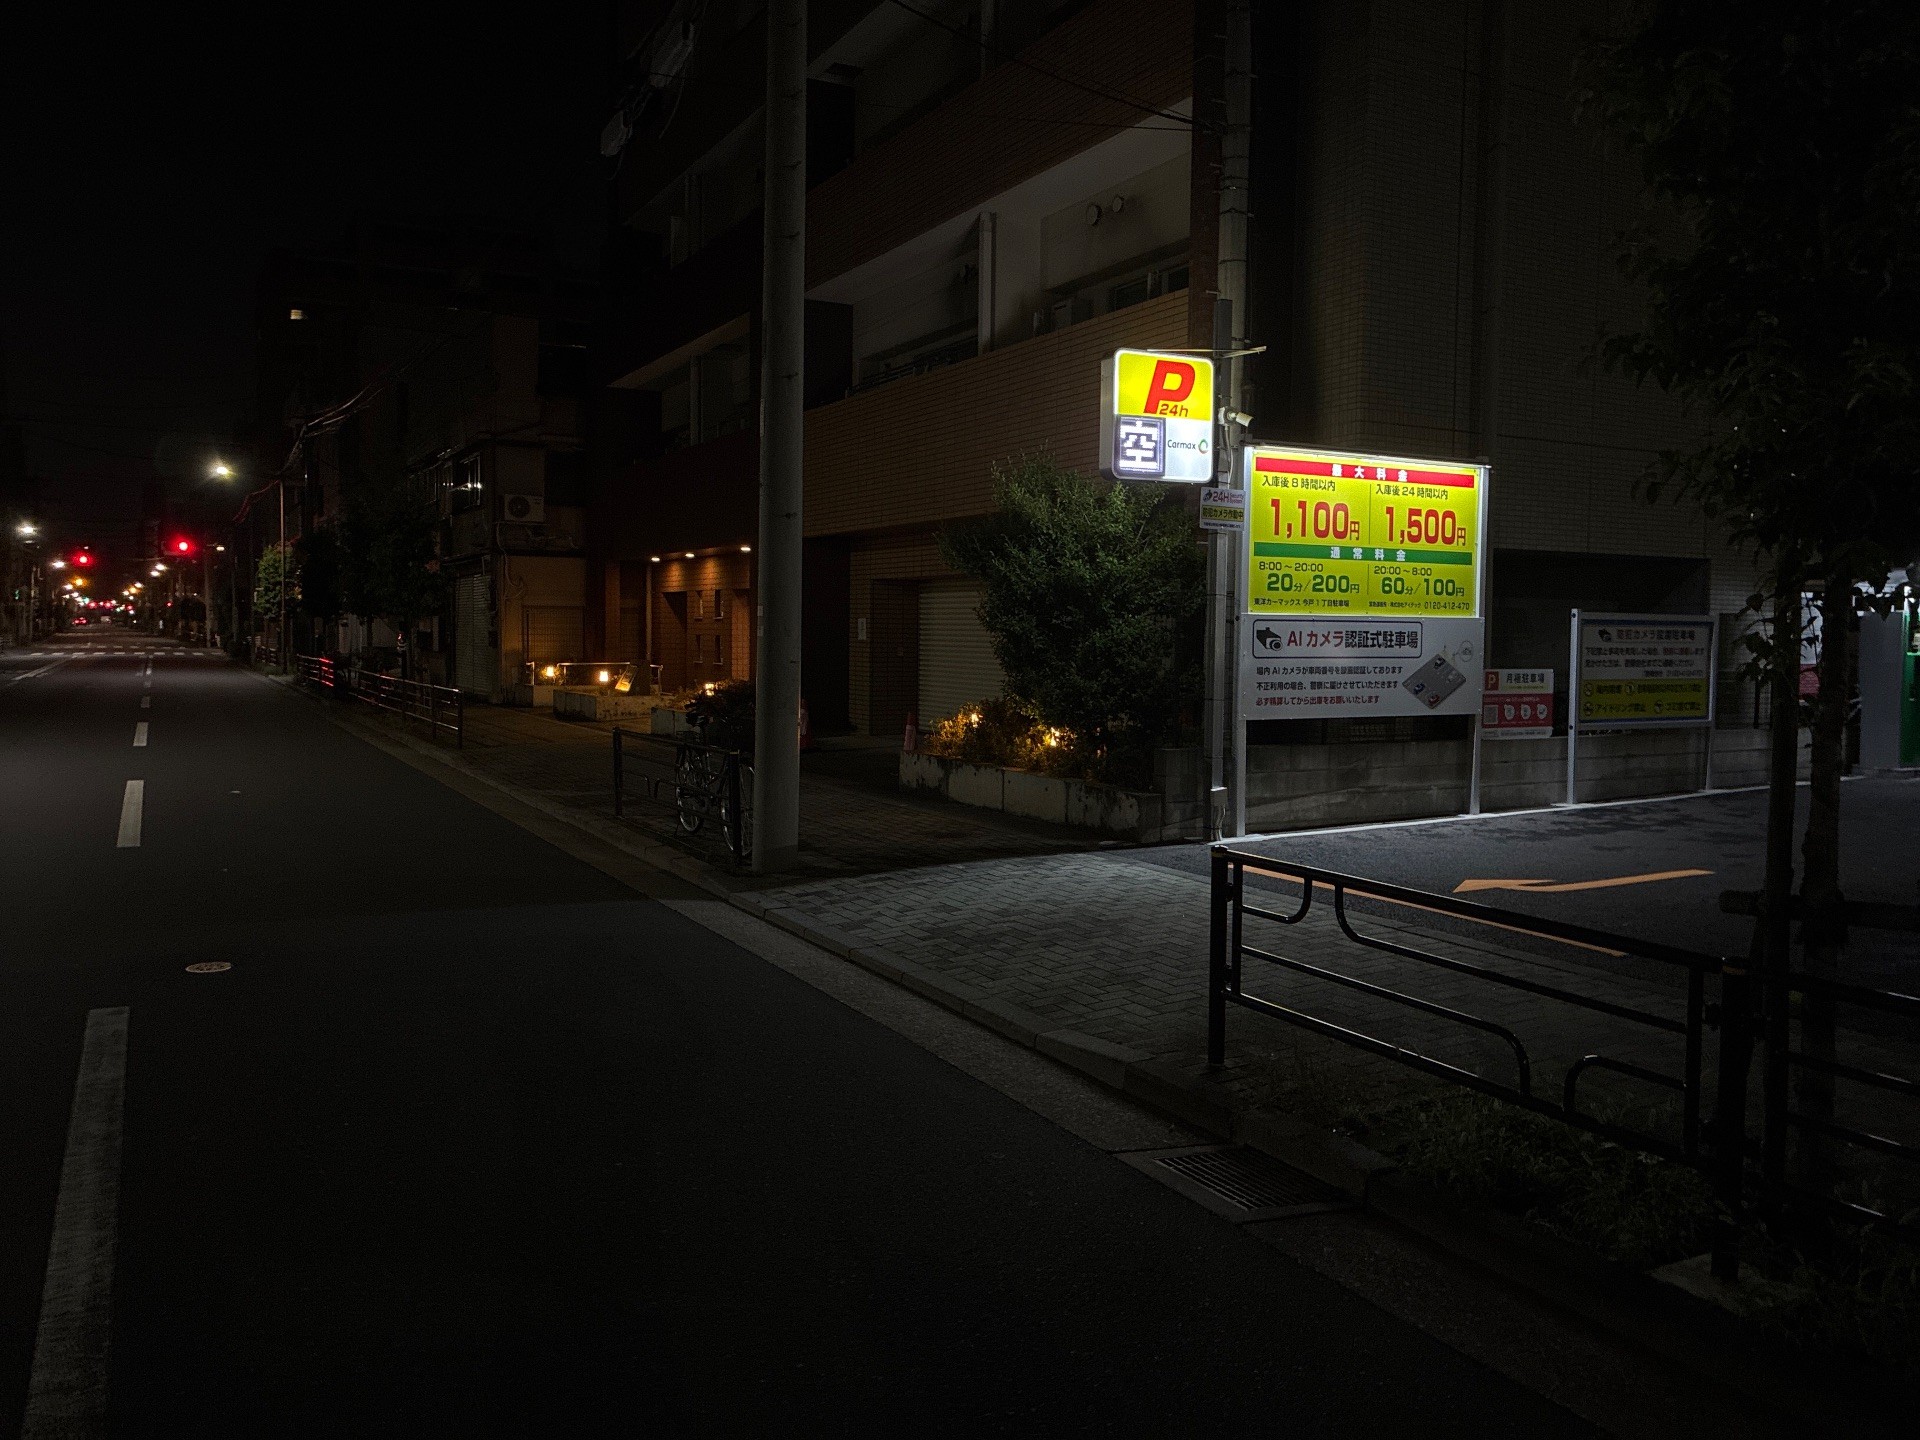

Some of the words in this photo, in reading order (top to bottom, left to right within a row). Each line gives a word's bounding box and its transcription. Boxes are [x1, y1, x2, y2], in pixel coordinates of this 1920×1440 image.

[1143, 359, 1196, 415] P
[1159, 403, 1188, 417] 24h
[1119, 420, 1158, 470] 空
[1167, 439, 1196, 450] Carmax
[1331, 463, 1408, 482] 最大料金
[1270, 498, 1360, 541] 1,100円
[1385, 505, 1466, 546] 1,500円
[1330, 546, 1406, 562] 通常料金
[1424, 601, 1470, 611] 0120-412-470
